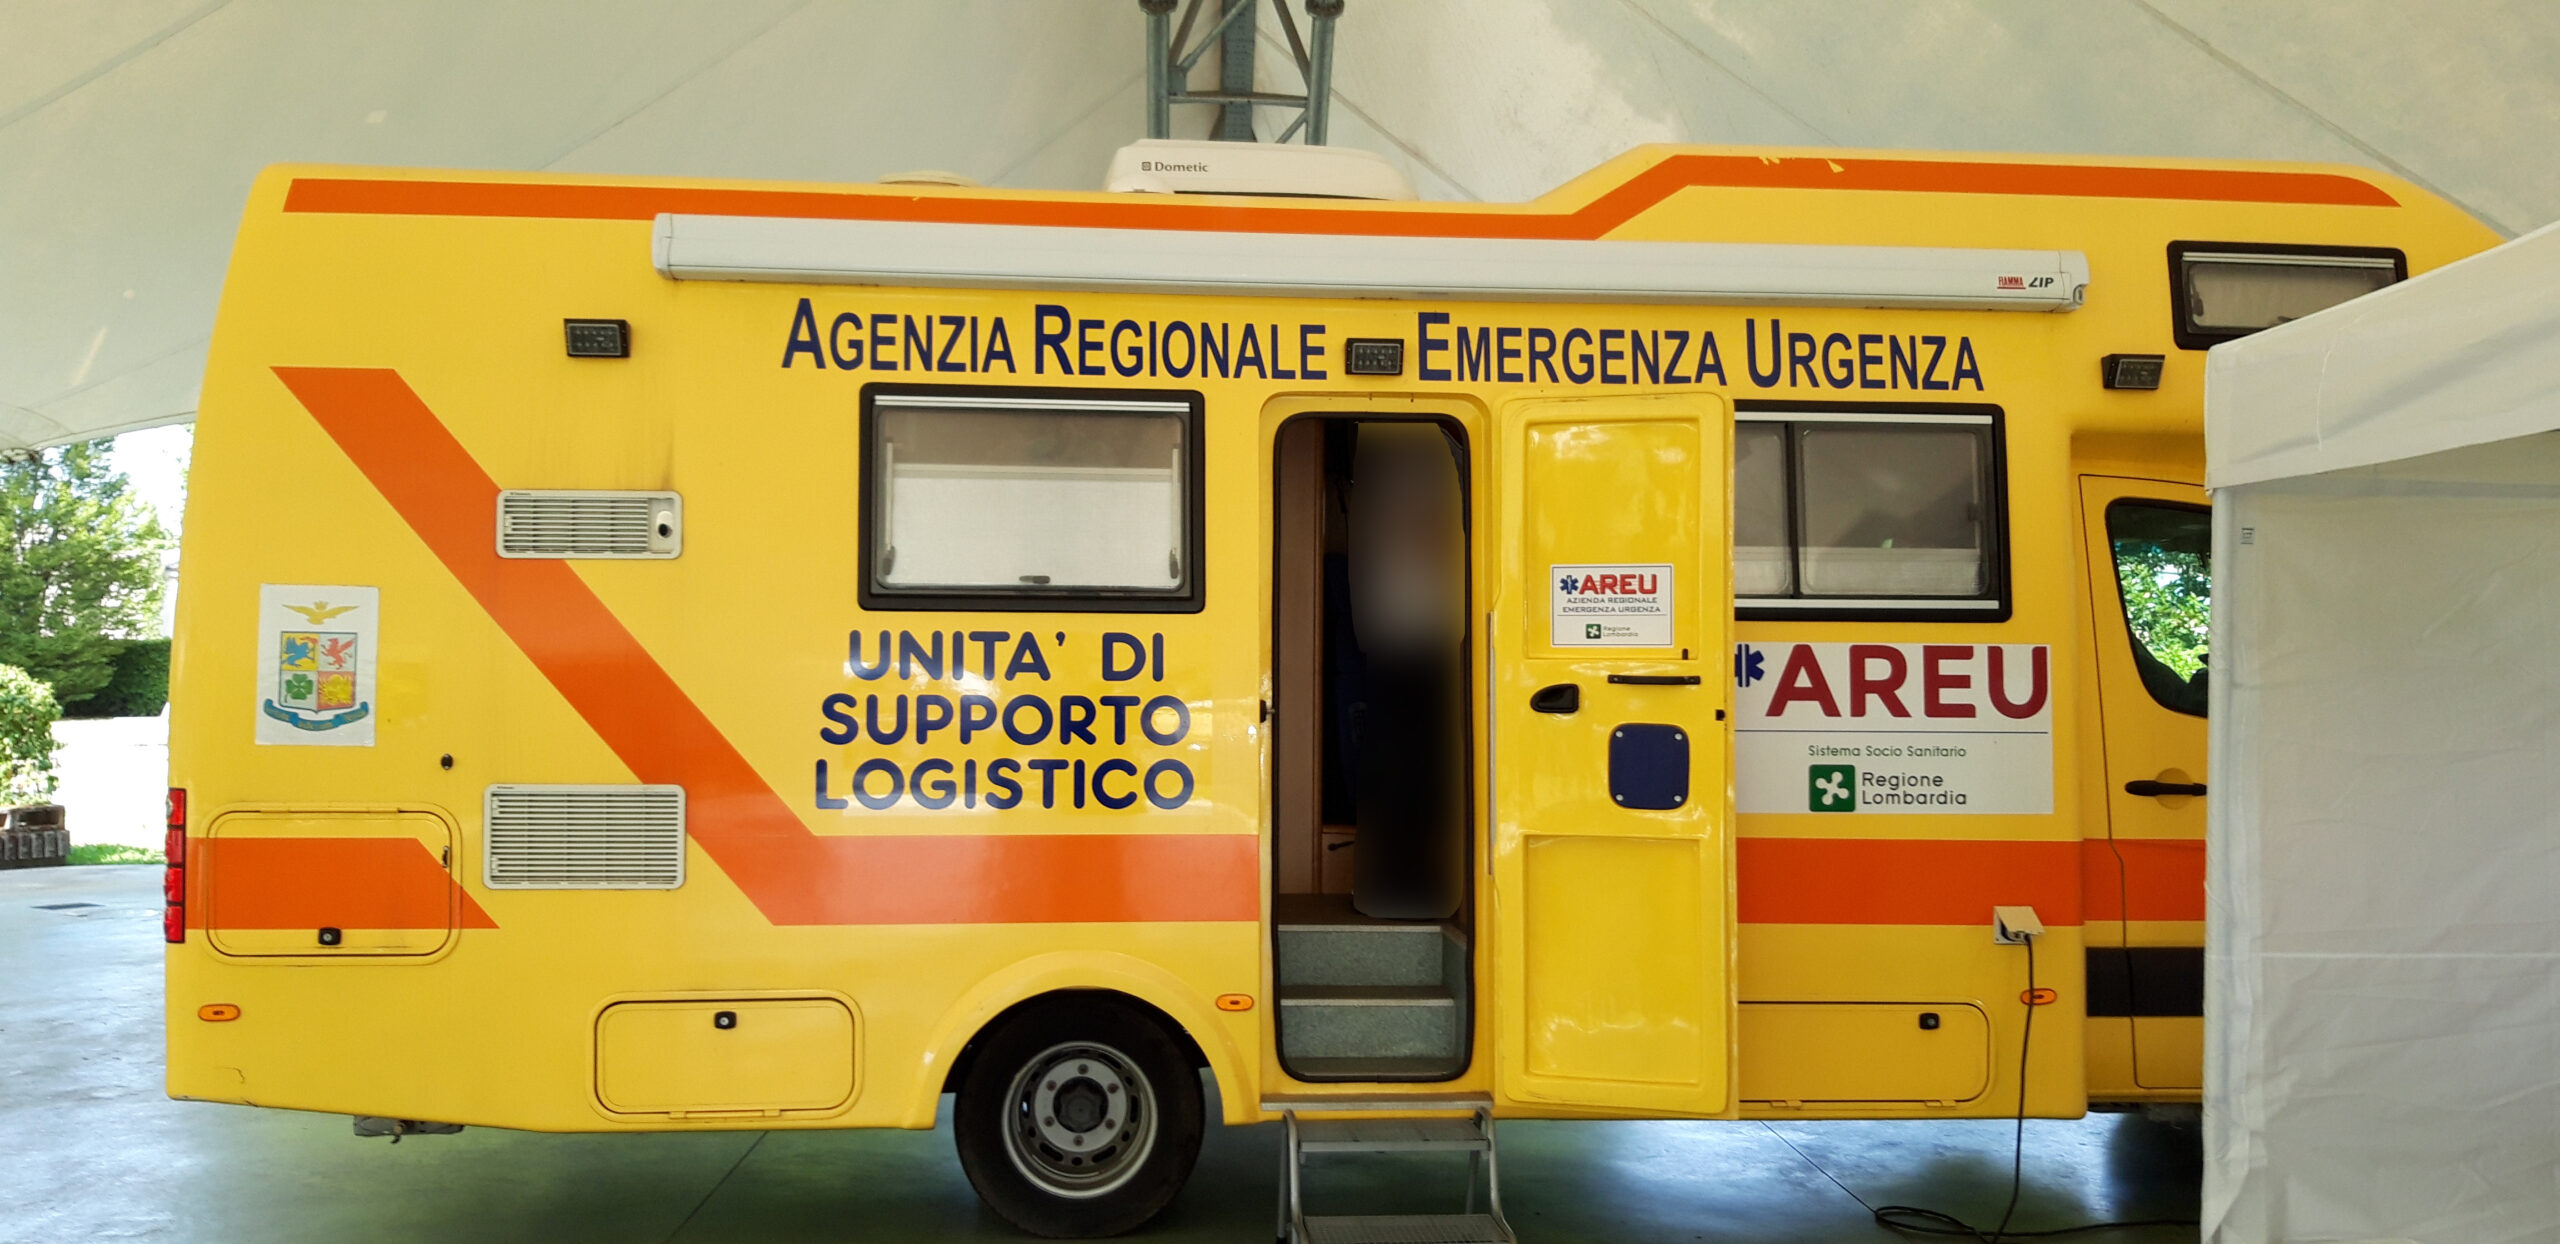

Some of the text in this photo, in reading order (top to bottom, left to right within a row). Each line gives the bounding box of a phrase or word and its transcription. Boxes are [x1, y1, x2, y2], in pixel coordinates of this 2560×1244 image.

[1155, 161, 1208, 173] Dometic
[1998, 276, 2054, 288] FIAMMA ZIP
[782, 298, 1984, 391] AGENZIA REGIONALE EMERGENZA URGENZA
[1579, 573, 1657, 595] AREU
[1102, 632, 1164, 682] DI
[1765, 644, 2048, 719] AREU
[820, 693, 1192, 746] SUPPORTO
[1808, 744, 1967, 758] Sistema Socio Sanitario
[815, 757, 1195, 810] LOGISTICO
[1861, 771, 1944, 791] Regione
[1861, 789, 1967, 805] Lombardia
